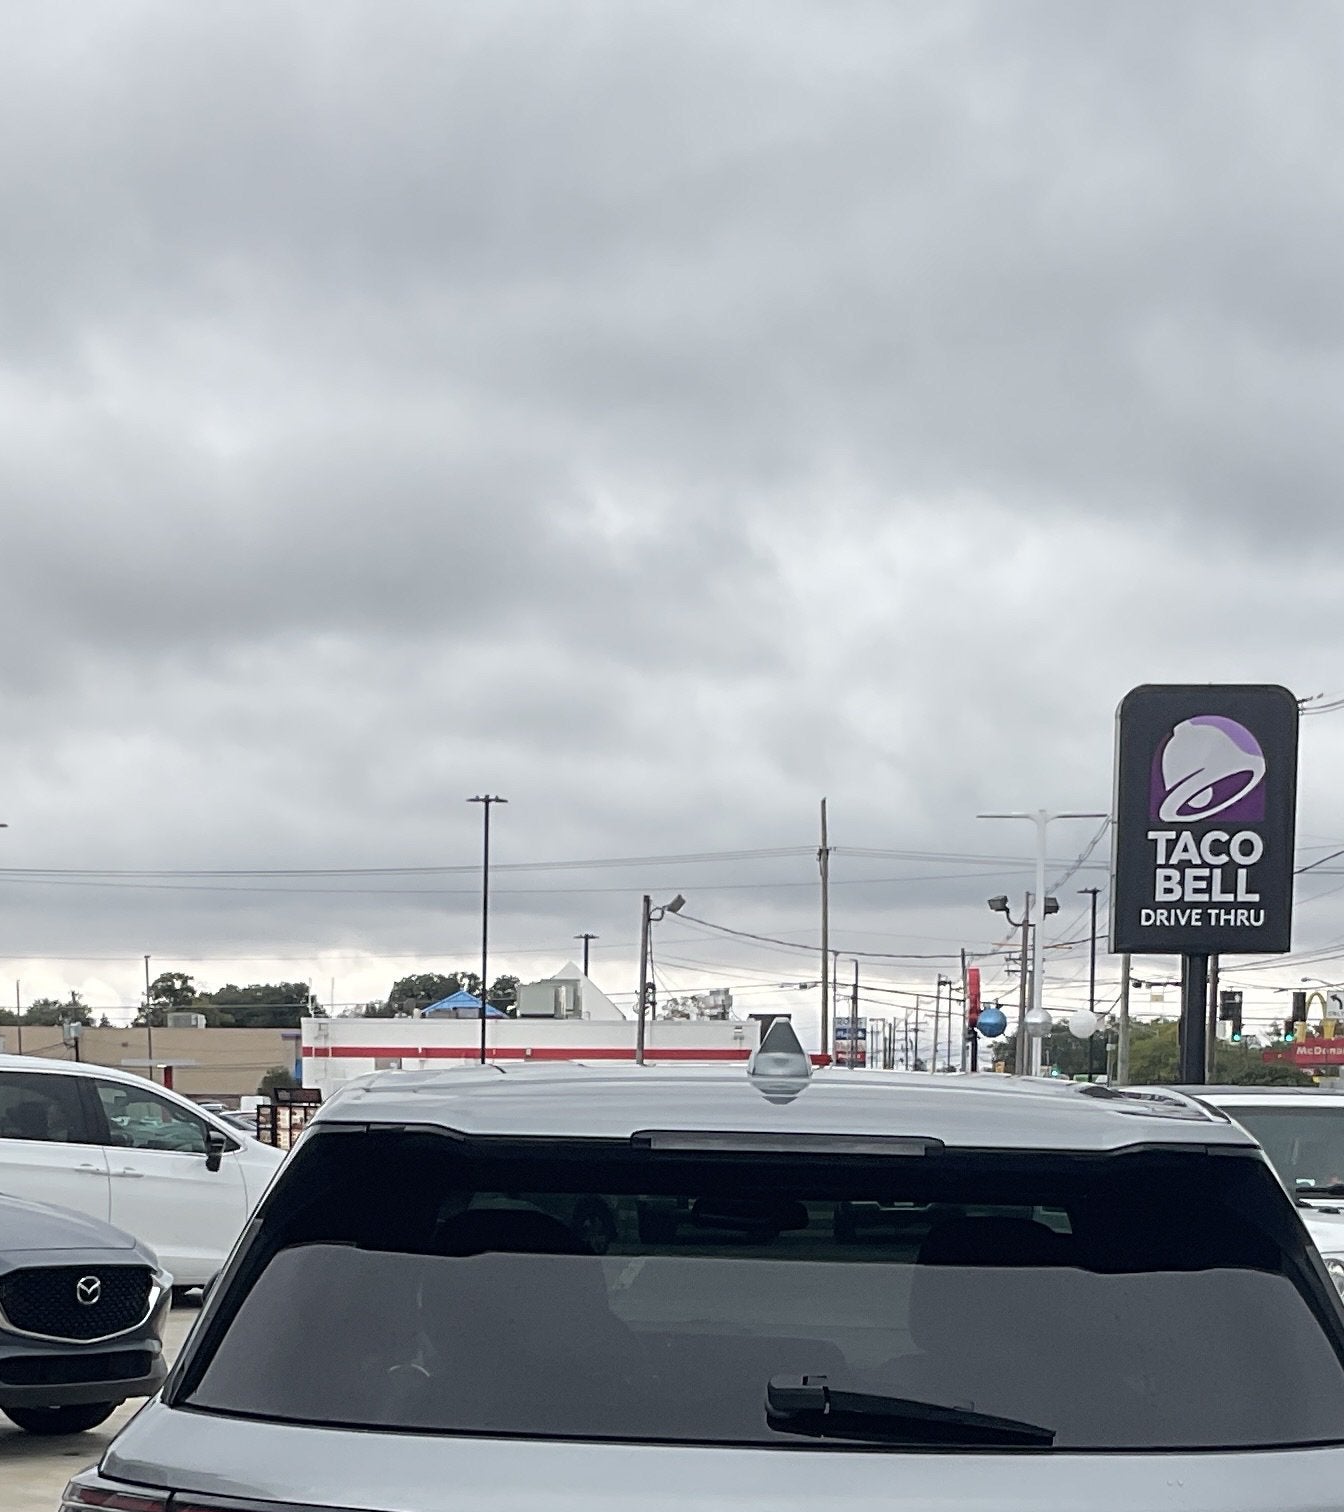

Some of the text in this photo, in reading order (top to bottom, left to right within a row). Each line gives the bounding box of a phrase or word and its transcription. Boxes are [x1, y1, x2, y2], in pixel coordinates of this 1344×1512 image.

[1147, 830, 1264, 865] TACO
[1155, 868, 1260, 902] BELL
[1140, 909, 1265, 926] DRIVE THRU
